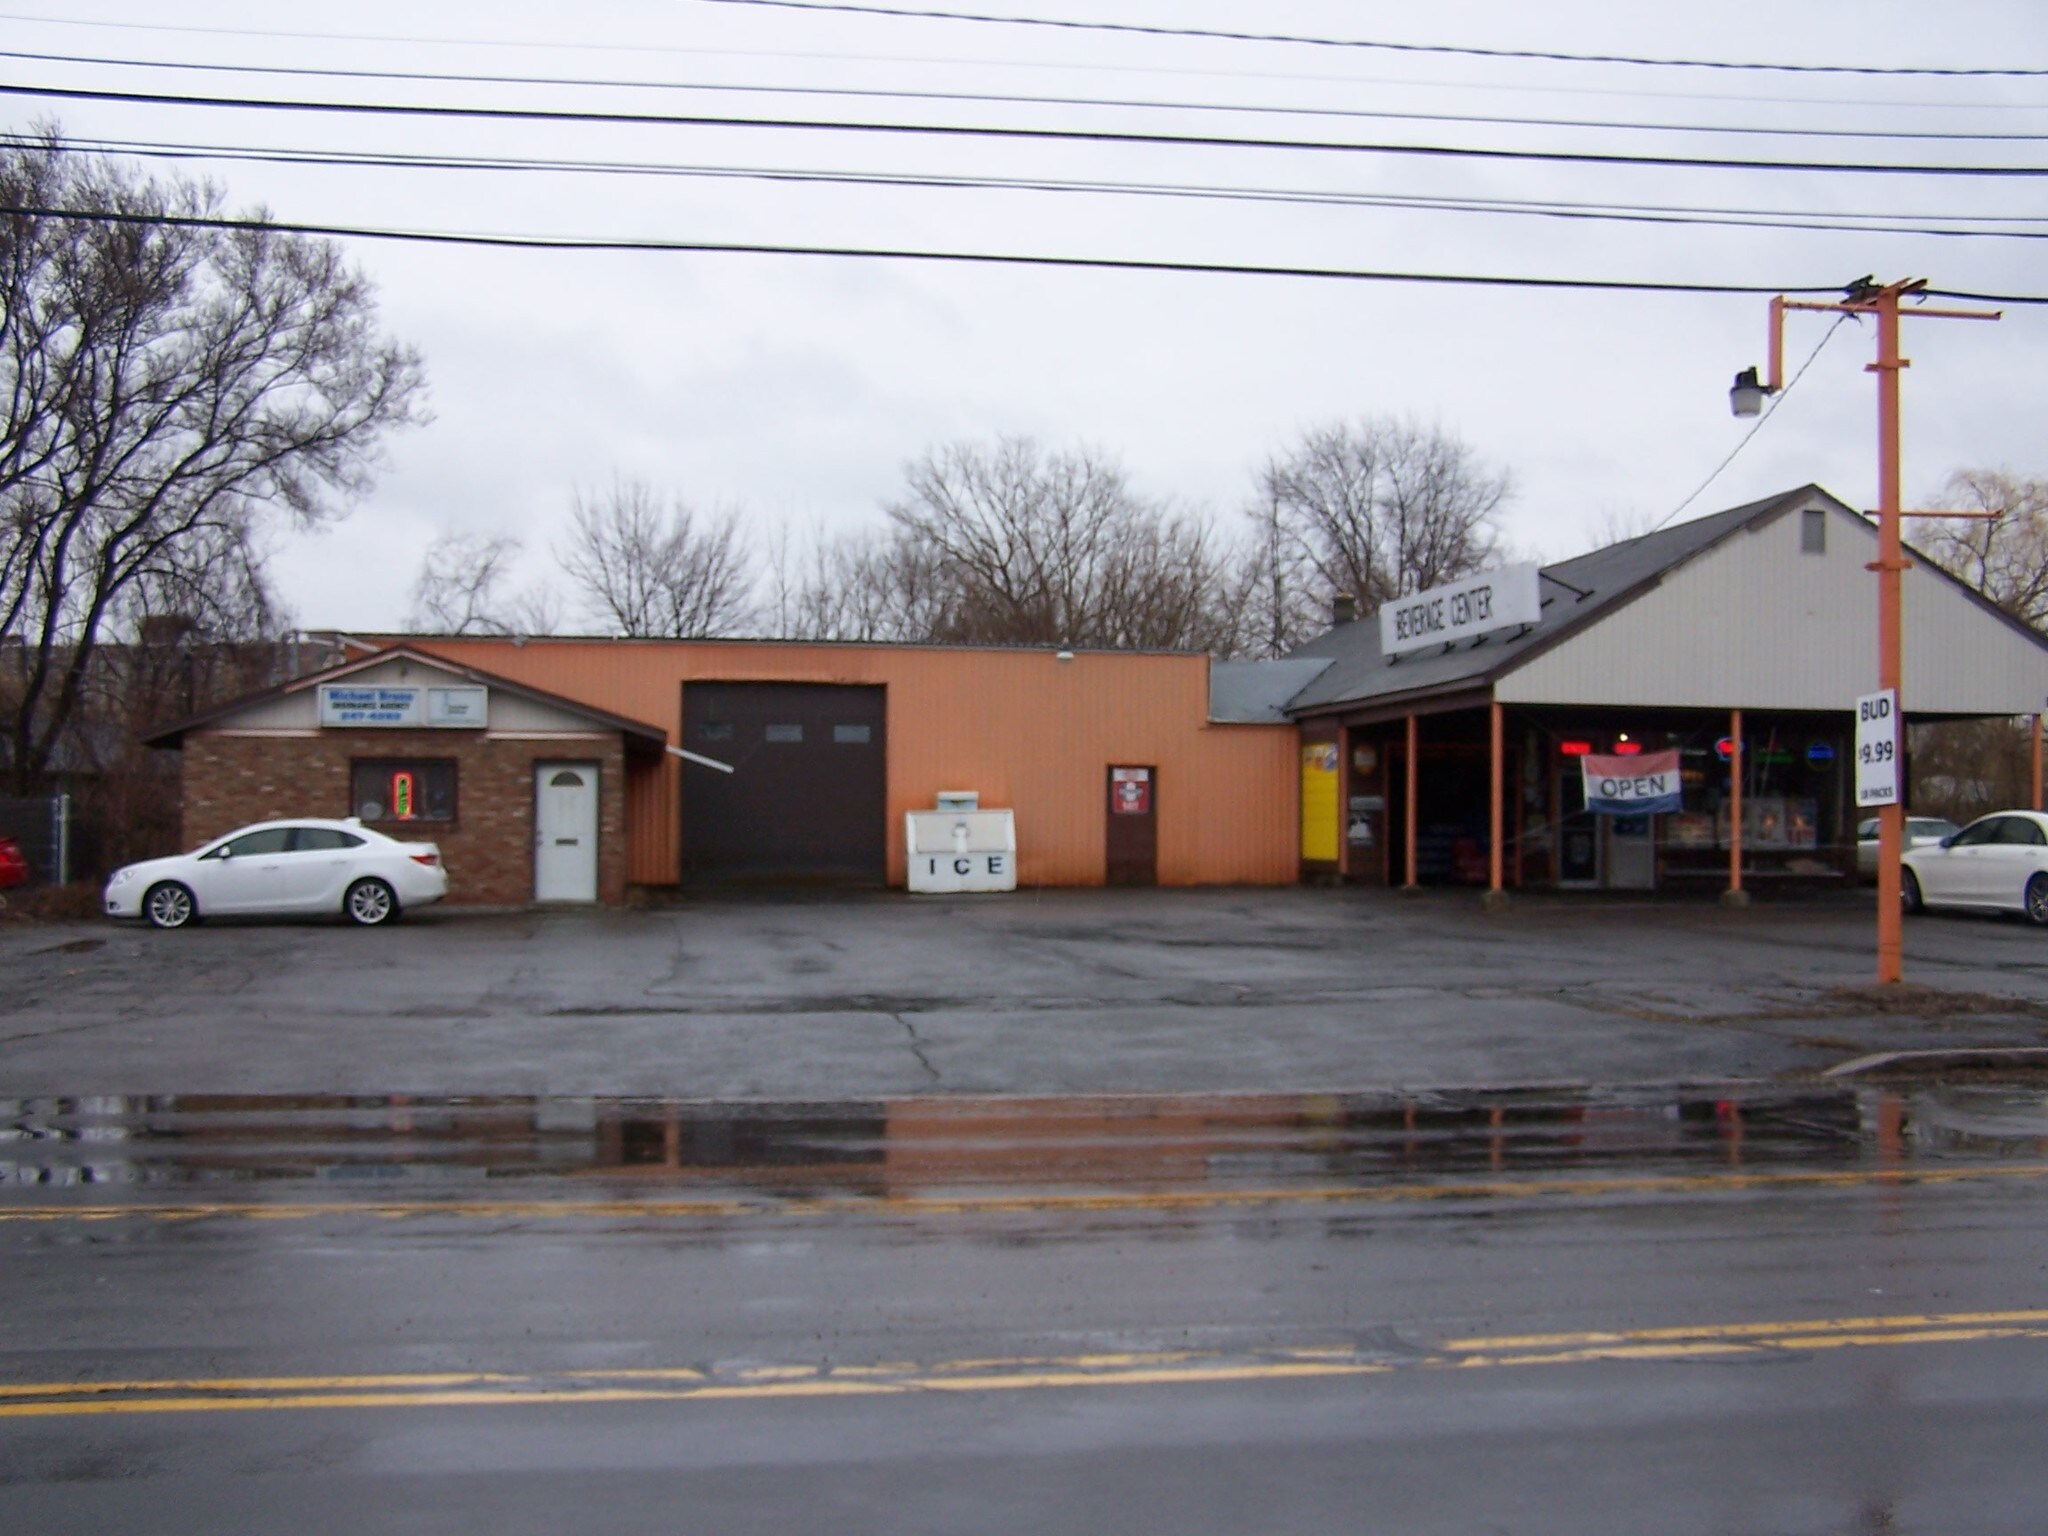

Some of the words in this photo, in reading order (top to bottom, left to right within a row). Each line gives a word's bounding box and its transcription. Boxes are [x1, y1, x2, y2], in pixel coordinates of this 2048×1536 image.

[1396, 599, 1446, 641] BEVERAGE
[1451, 585, 1493, 626] CENTER
[332, 702, 377, 710] INSURANCE
[380, 702, 411, 710] AGENCY
[1861, 699, 1890, 722] BUD
[1859, 741, 1894, 765] $9.99
[1600, 774, 1666, 800] OPEN
[1870, 786, 1893, 798] PACKS
[929, 856, 1004, 876] ICE
